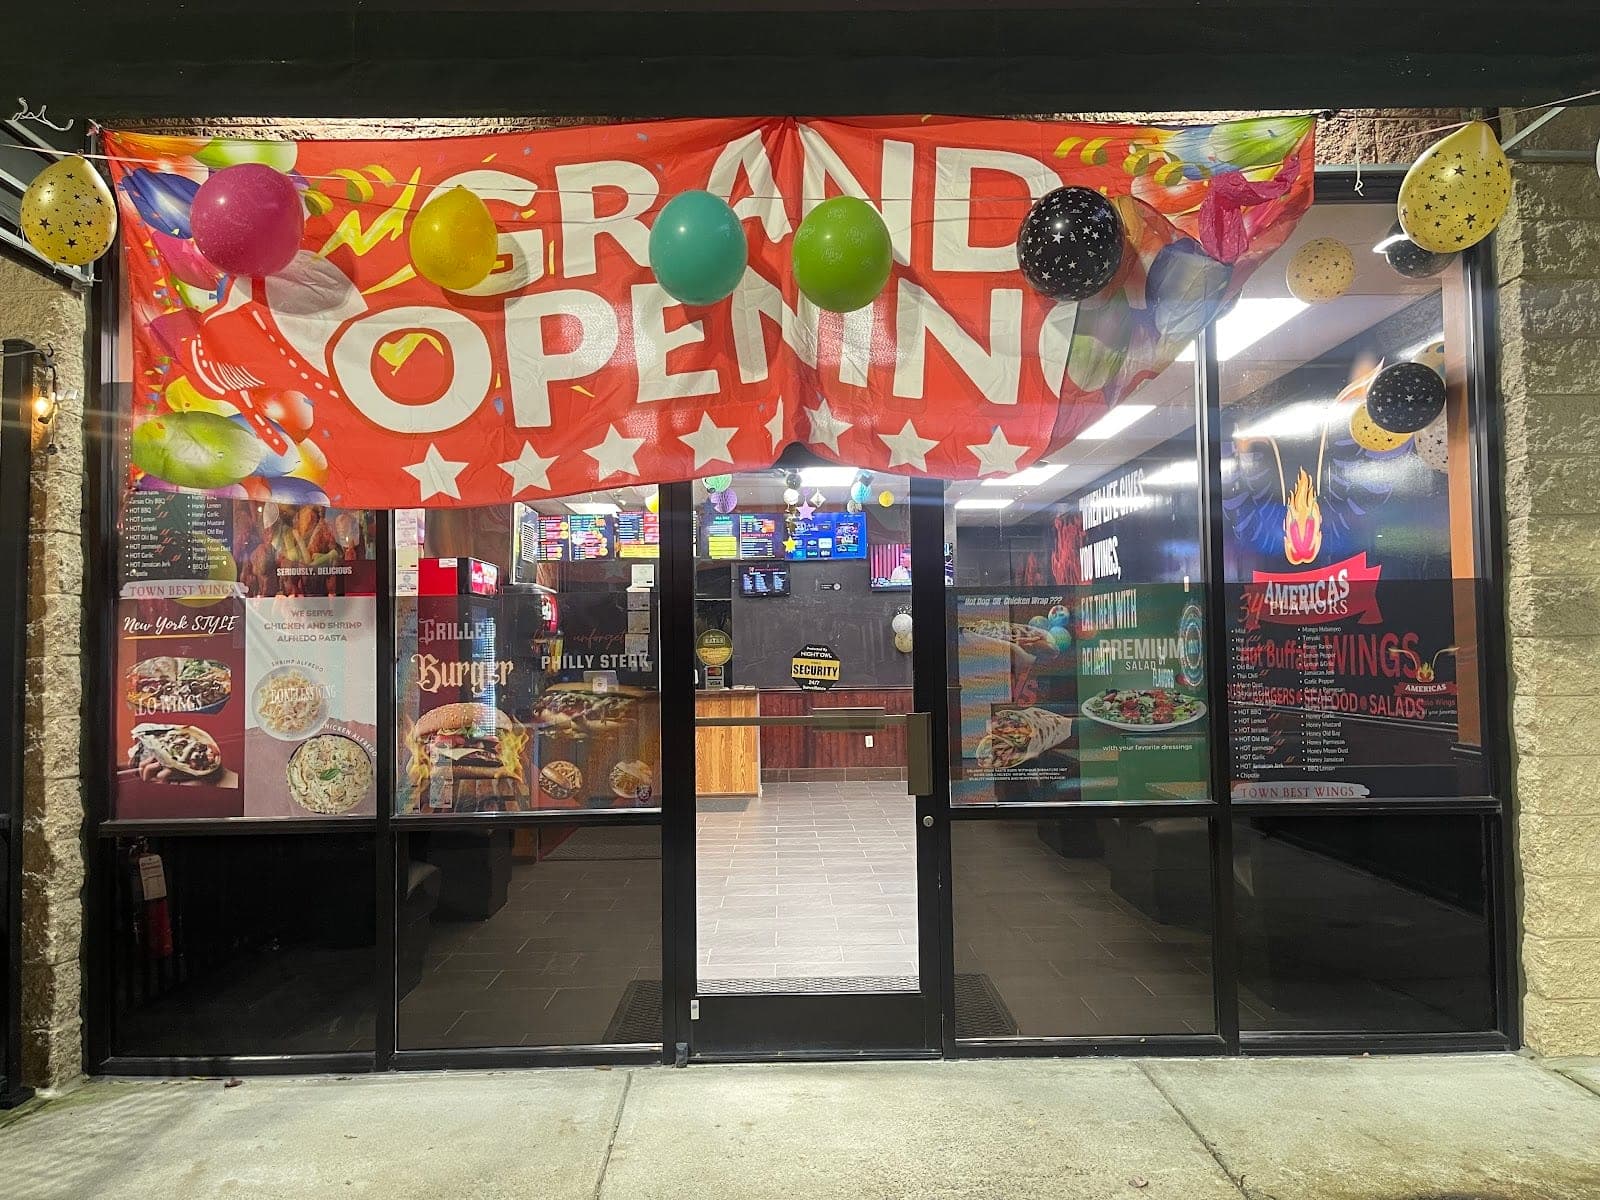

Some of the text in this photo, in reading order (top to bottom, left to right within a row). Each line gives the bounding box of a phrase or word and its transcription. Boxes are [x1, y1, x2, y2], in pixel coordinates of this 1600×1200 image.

[421, 122, 1064, 296] GRAND
[1080, 544, 1093, 581] YOU
[317, 566, 353, 575] DELICIOUS
[131, 584, 235, 597] TOWN BEST WINGS
[1264, 568, 1350, 611] AMERICAS
[1004, 597, 1030, 605] Chicken
[1031, 597, 1049, 607] Wrap
[1115, 589, 1137, 629] WITH
[1269, 600, 1348, 616] FLAVORS
[124, 615, 240, 635] New York STYLE
[264, 621, 362, 630] CHICKEN AND SHRIMP
[277, 634, 348, 642] ALFREDO PASTA
[1100, 638, 1186, 659] PREMIUM
[1324, 632, 1421, 679] WINGS
[541, 655, 594, 669] PHILLY
[1126, 661, 1156, 670] SALAD
[411, 653, 514, 693] Burger
[793, 664, 838, 677] SECURITY
[1405, 684, 1447, 693] AMERICAS
[1369, 694, 1426, 719] SALADS
[1241, 786, 1354, 798] TOWN BEST WINGS
